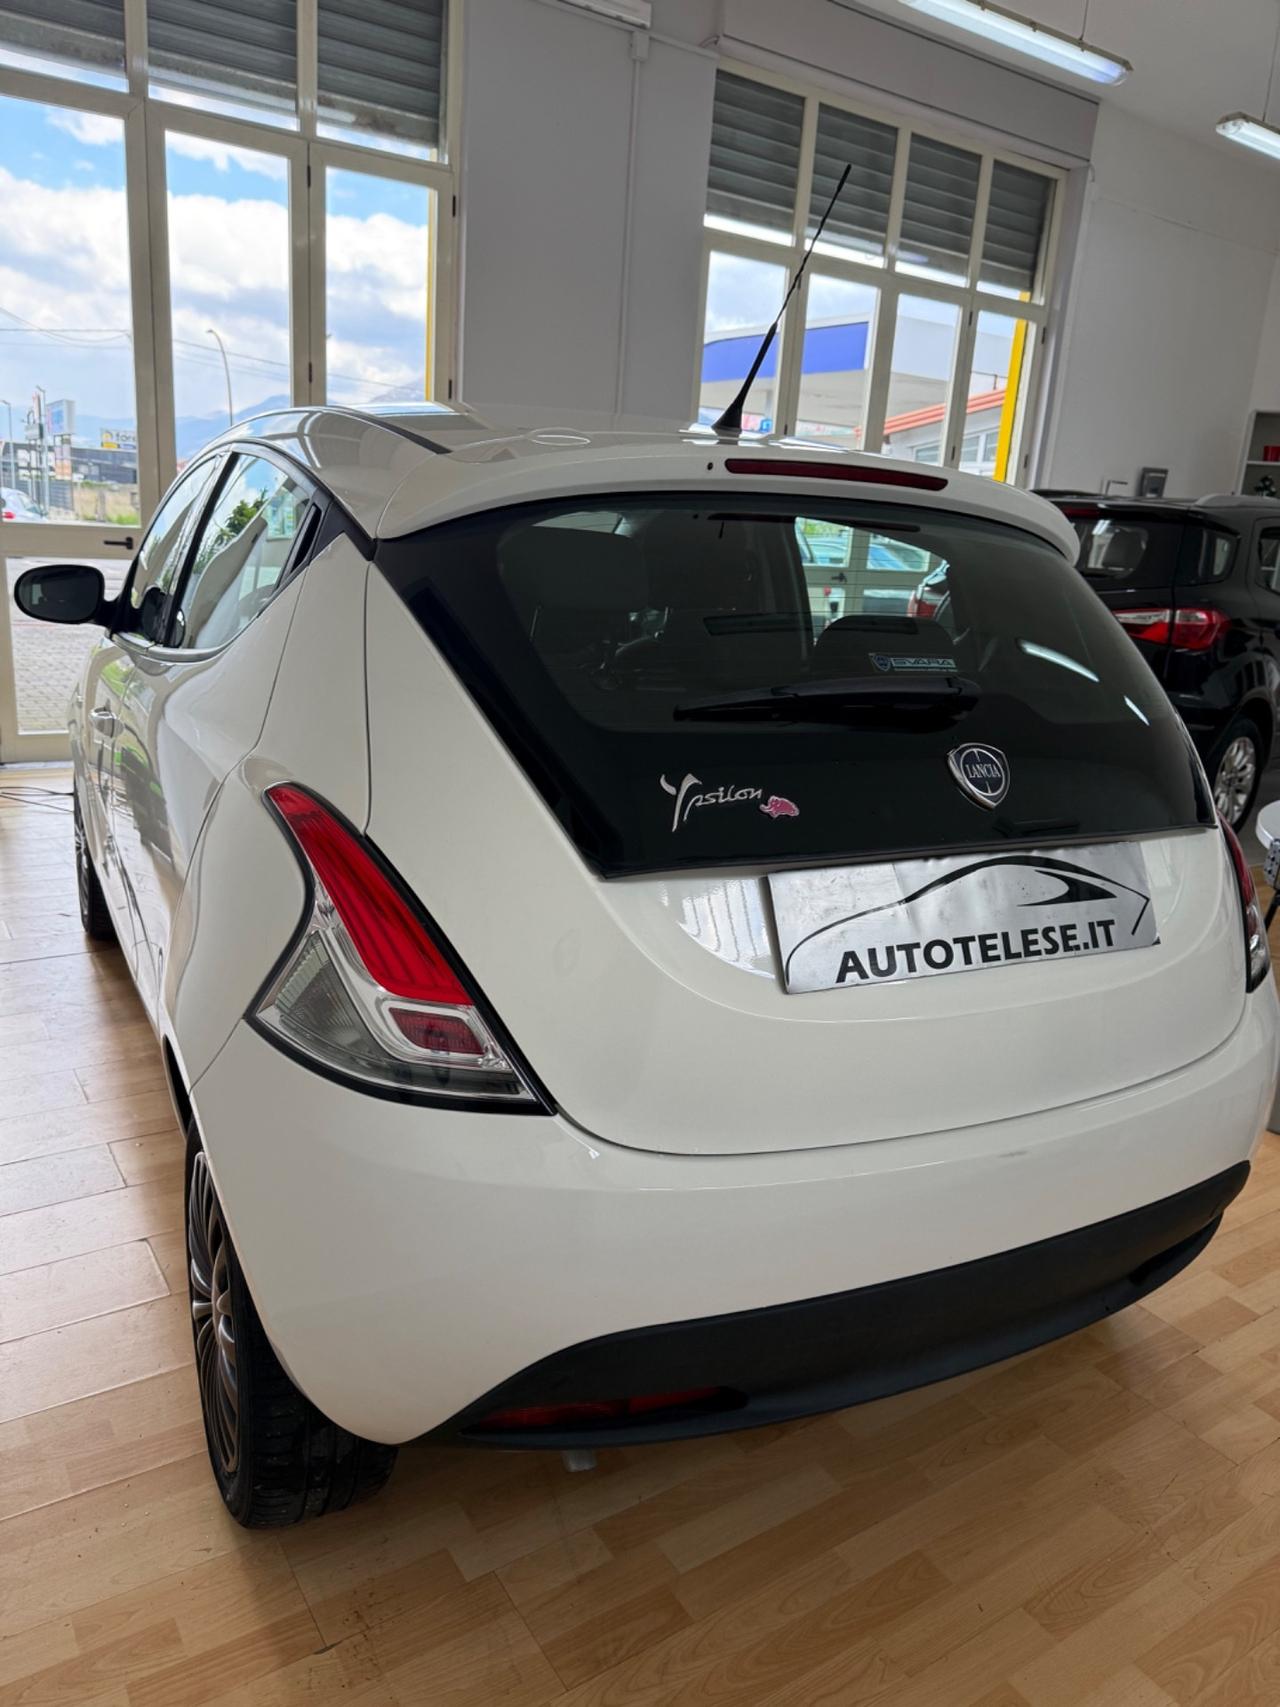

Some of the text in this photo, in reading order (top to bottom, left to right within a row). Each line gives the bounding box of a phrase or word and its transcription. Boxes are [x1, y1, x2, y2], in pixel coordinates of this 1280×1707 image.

[964, 763, 1002, 779] LANCIA
[659, 773, 763, 833] Ypsilon
[835, 919, 1116, 984] AUTOTELESE.IT
